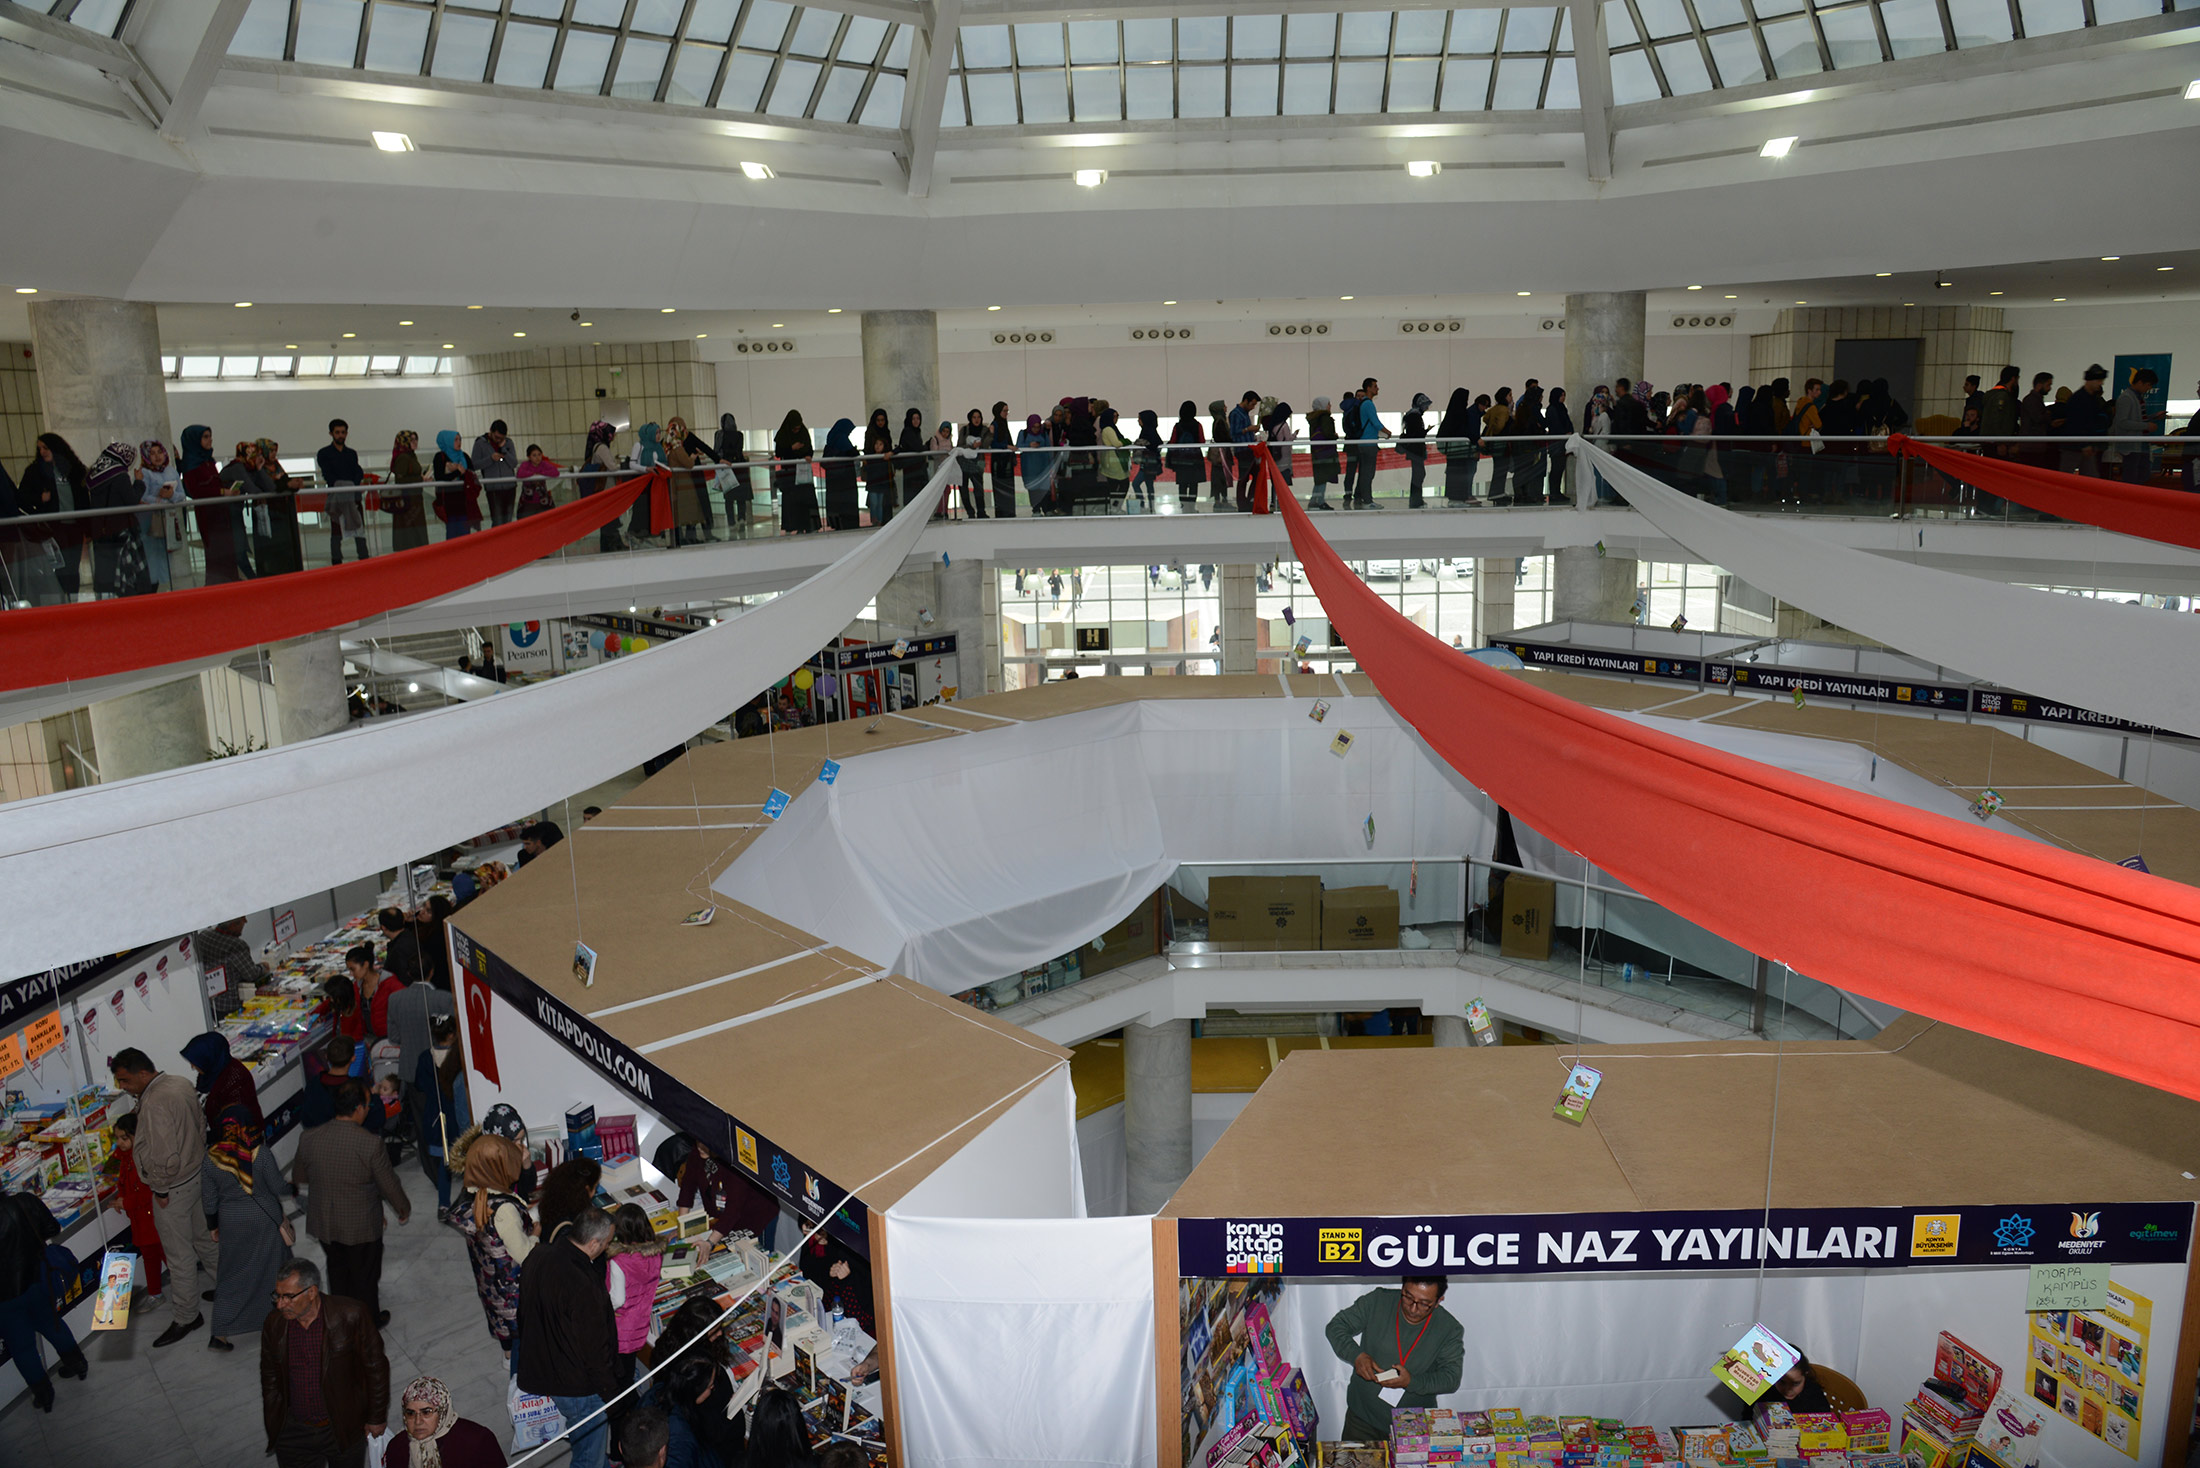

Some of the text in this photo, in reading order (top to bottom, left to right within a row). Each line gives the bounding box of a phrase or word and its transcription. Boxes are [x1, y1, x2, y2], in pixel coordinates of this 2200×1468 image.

[507, 648, 548, 661] Pearson
[1533, 651, 1555, 662] YAPI
[1556, 654, 1585, 666] KREDİ
[1587, 658, 1639, 671] YAYINLARI
[1758, 675, 1784, 687] YAPI
[1787, 677, 1823, 691] KREDİ
[1825, 682, 1890, 698] YAYINLARI
[2040, 705, 2073, 720] YAPI
[537, 996, 653, 1100] KİTAPDOLU.COM
[1226, 1221, 1283, 1238] konya
[1226, 1236, 1283, 1253] kitap
[1325, 1243, 1356, 1260] B2
[1367, 1225, 1898, 1268] GÜLCE NAZ YAYINLARI
[2058, 1240, 2106, 1249] MEDENİYET
[1226, 1251, 1283, 1267] günleri
[2037, 1266, 2082, 1280] MORPA
[2043, 1279, 2098, 1295] KAMPÜS
